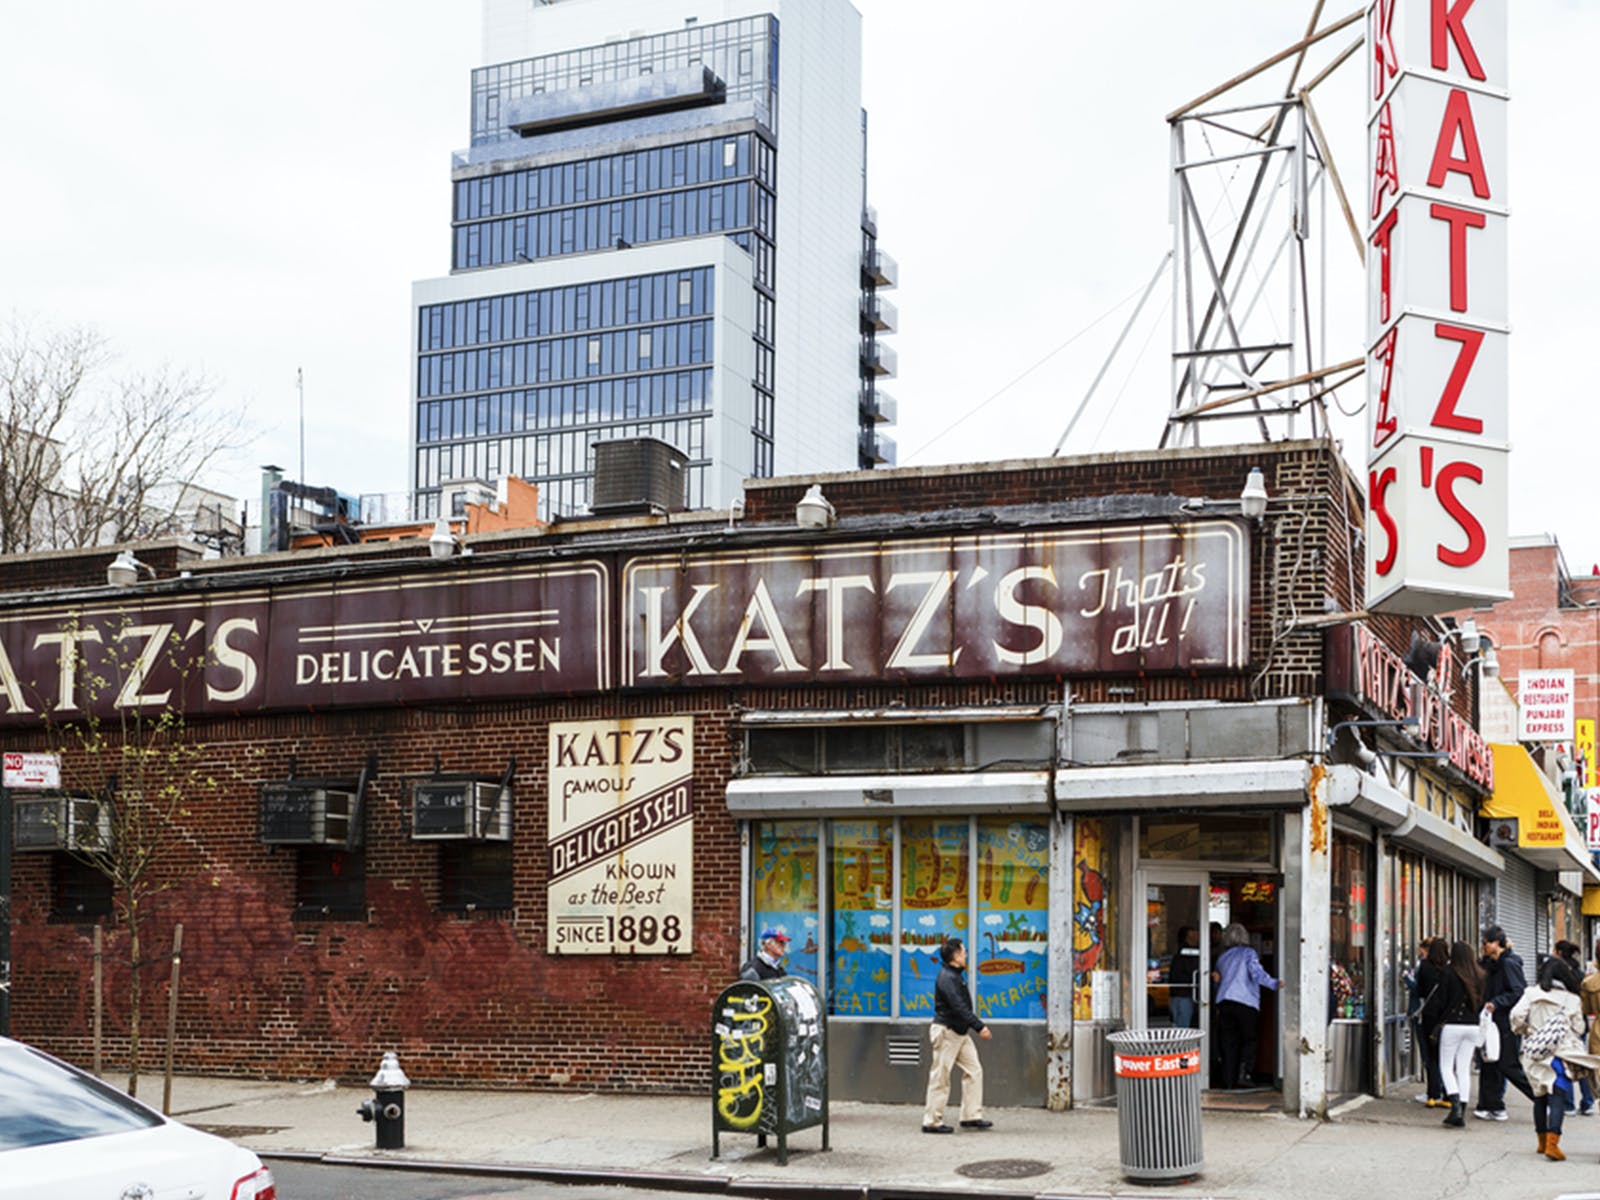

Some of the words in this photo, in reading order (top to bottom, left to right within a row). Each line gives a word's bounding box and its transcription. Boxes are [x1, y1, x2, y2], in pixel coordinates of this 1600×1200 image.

[1078, 554, 1207, 618] That's
[637, 564, 1064, 678] KATZ'S
[295, 637, 561, 685] DELICATESSEN
[1527, 678, 1565, 689] INDIAN
[1523, 693, 1569, 705] RESTAURANT
[1526, 709, 1565, 719] PUNJABI
[1525, 723, 1564, 733] EXPRESS
[554, 727, 684, 768] KATZ'S
[5, 756, 22, 769] NO
[563, 777, 636, 823] FAMOUS
[552, 784, 688, 876] DELICATESSEN
[605, 863, 676, 880] KNOWN
[568, 892, 587, 906] as
[556, 926, 606, 944] SINCE
[836, 988, 890, 1014] GATE
[977, 975, 1048, 1017] AMERICA
[1154, 1057, 1180, 1071] East
